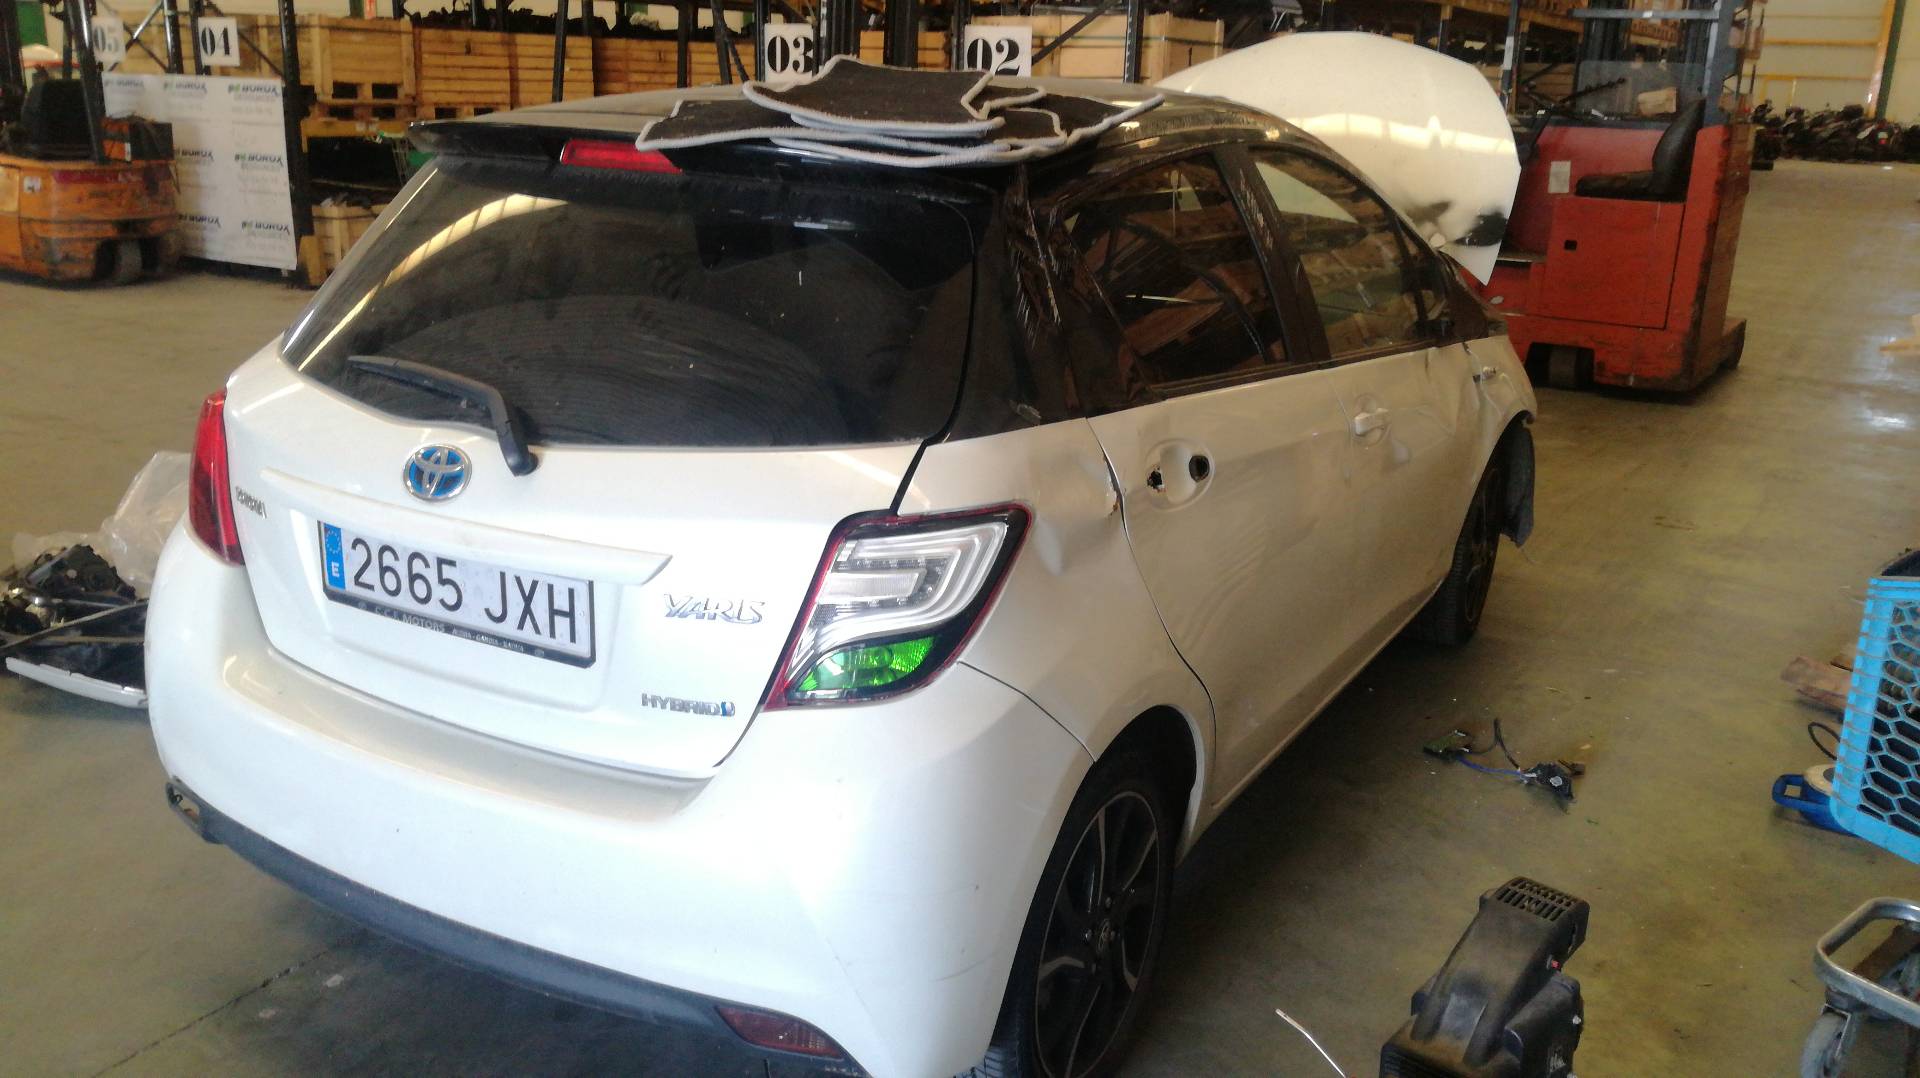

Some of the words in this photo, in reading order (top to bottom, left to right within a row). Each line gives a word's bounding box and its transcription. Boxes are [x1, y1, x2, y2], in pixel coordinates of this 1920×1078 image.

[93, 24, 119, 53] 05
[201, 26, 231, 56] 04
[767, 35, 813, 74] 03
[967, 38, 1020, 77] 02
[332, 562, 340, 577] E
[351, 537, 463, 612] 2665
[484, 571, 577, 643] JXH
[402, 613, 445, 633] MOTORS
[664, 593, 766, 625] YARIS
[641, 693, 720, 716] HYBRID
